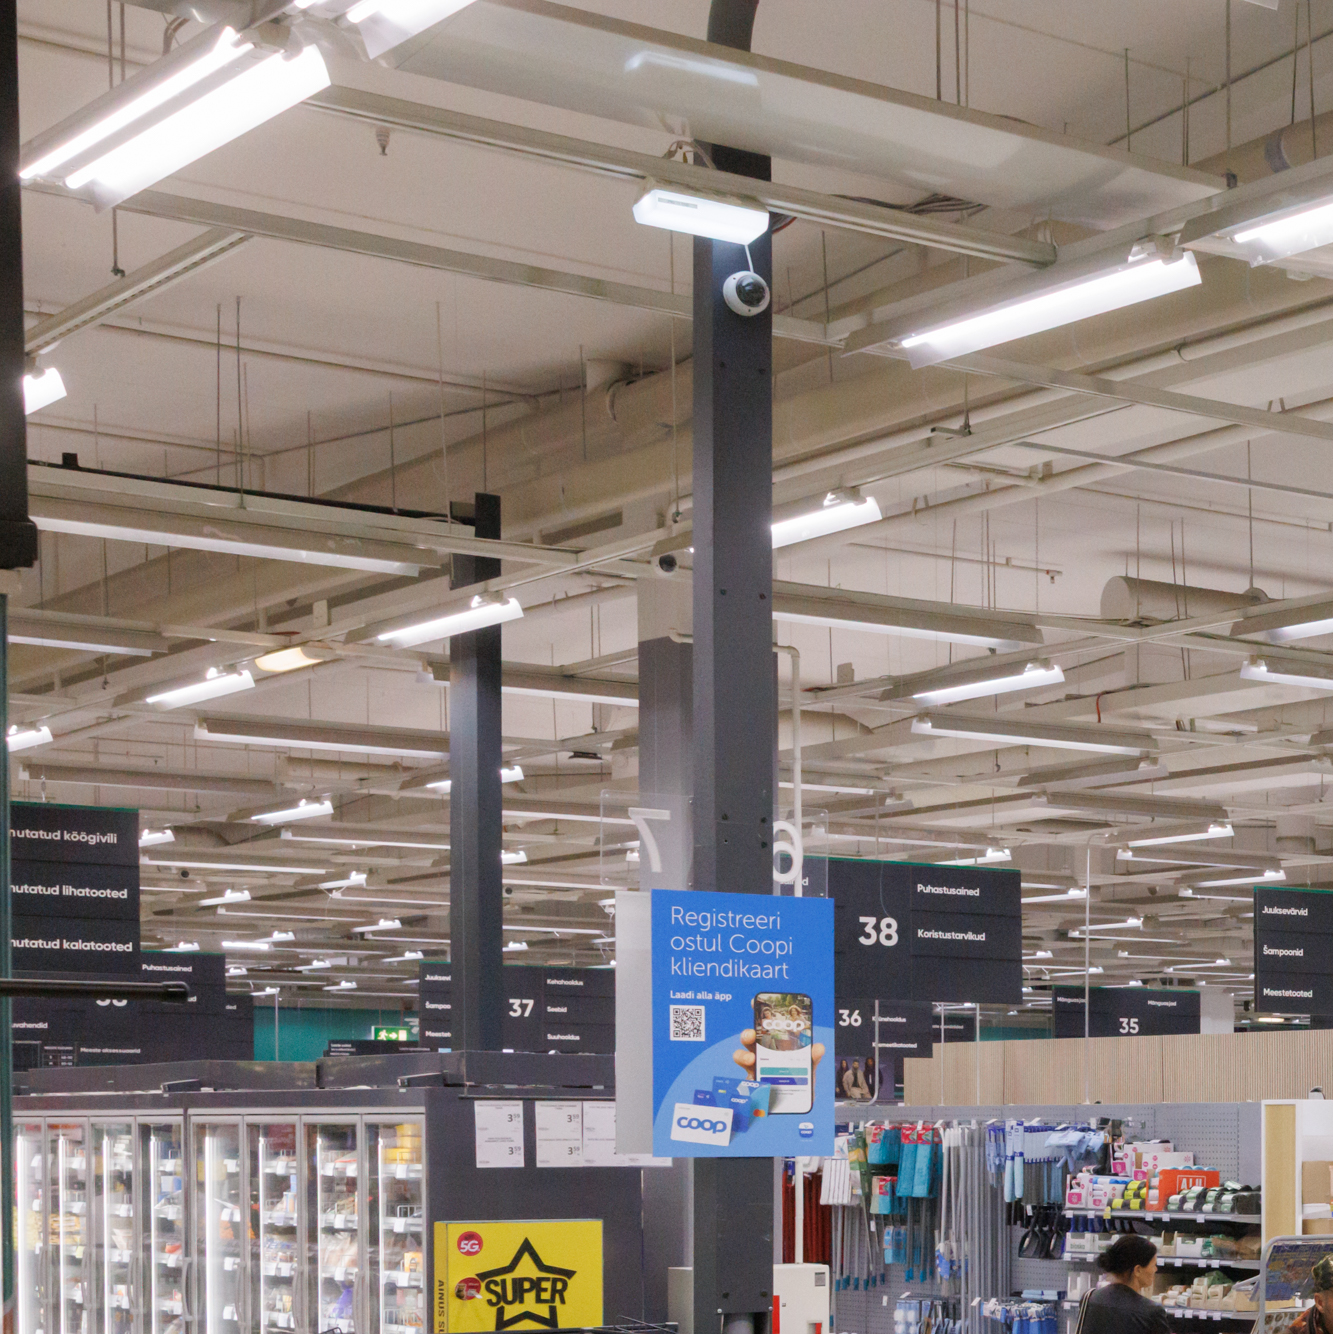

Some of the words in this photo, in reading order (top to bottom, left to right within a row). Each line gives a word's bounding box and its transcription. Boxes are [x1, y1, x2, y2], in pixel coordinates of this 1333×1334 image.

[64, 831, 118, 845] köögivili
[62, 885, 128, 899] lihatooted
[917, 883, 980, 896] Puhastusained
[670, 906, 781, 931] Registreeri
[1261, 905, 1309, 917] Juuksevärvid
[858, 915, 899, 947] 38
[917, 928, 986, 941] Koristustarvikud
[62, 939, 133, 952] kalatooted
[670, 934, 722, 952] ostul
[729, 934, 793, 959] Coopi
[1262, 945, 1304, 957] Šampoonid
[670, 957, 790, 980] kliendikaart
[425, 974, 451, 982] Juuksev
[670, 990, 694, 999] Laadi
[696, 991, 712, 999] alla
[714, 991, 732, 1002] äpp
[1263, 988, 1313, 998] Meestetooted
[508, 999, 534, 1018] 37
[838, 1009, 862, 1027] 36
[1119, 1017, 1139, 1034] 35
[677, 1116, 727, 1134] coop
[437, 1280, 446, 1318] AINUS
[484, 1276, 569, 1307] SUPER
